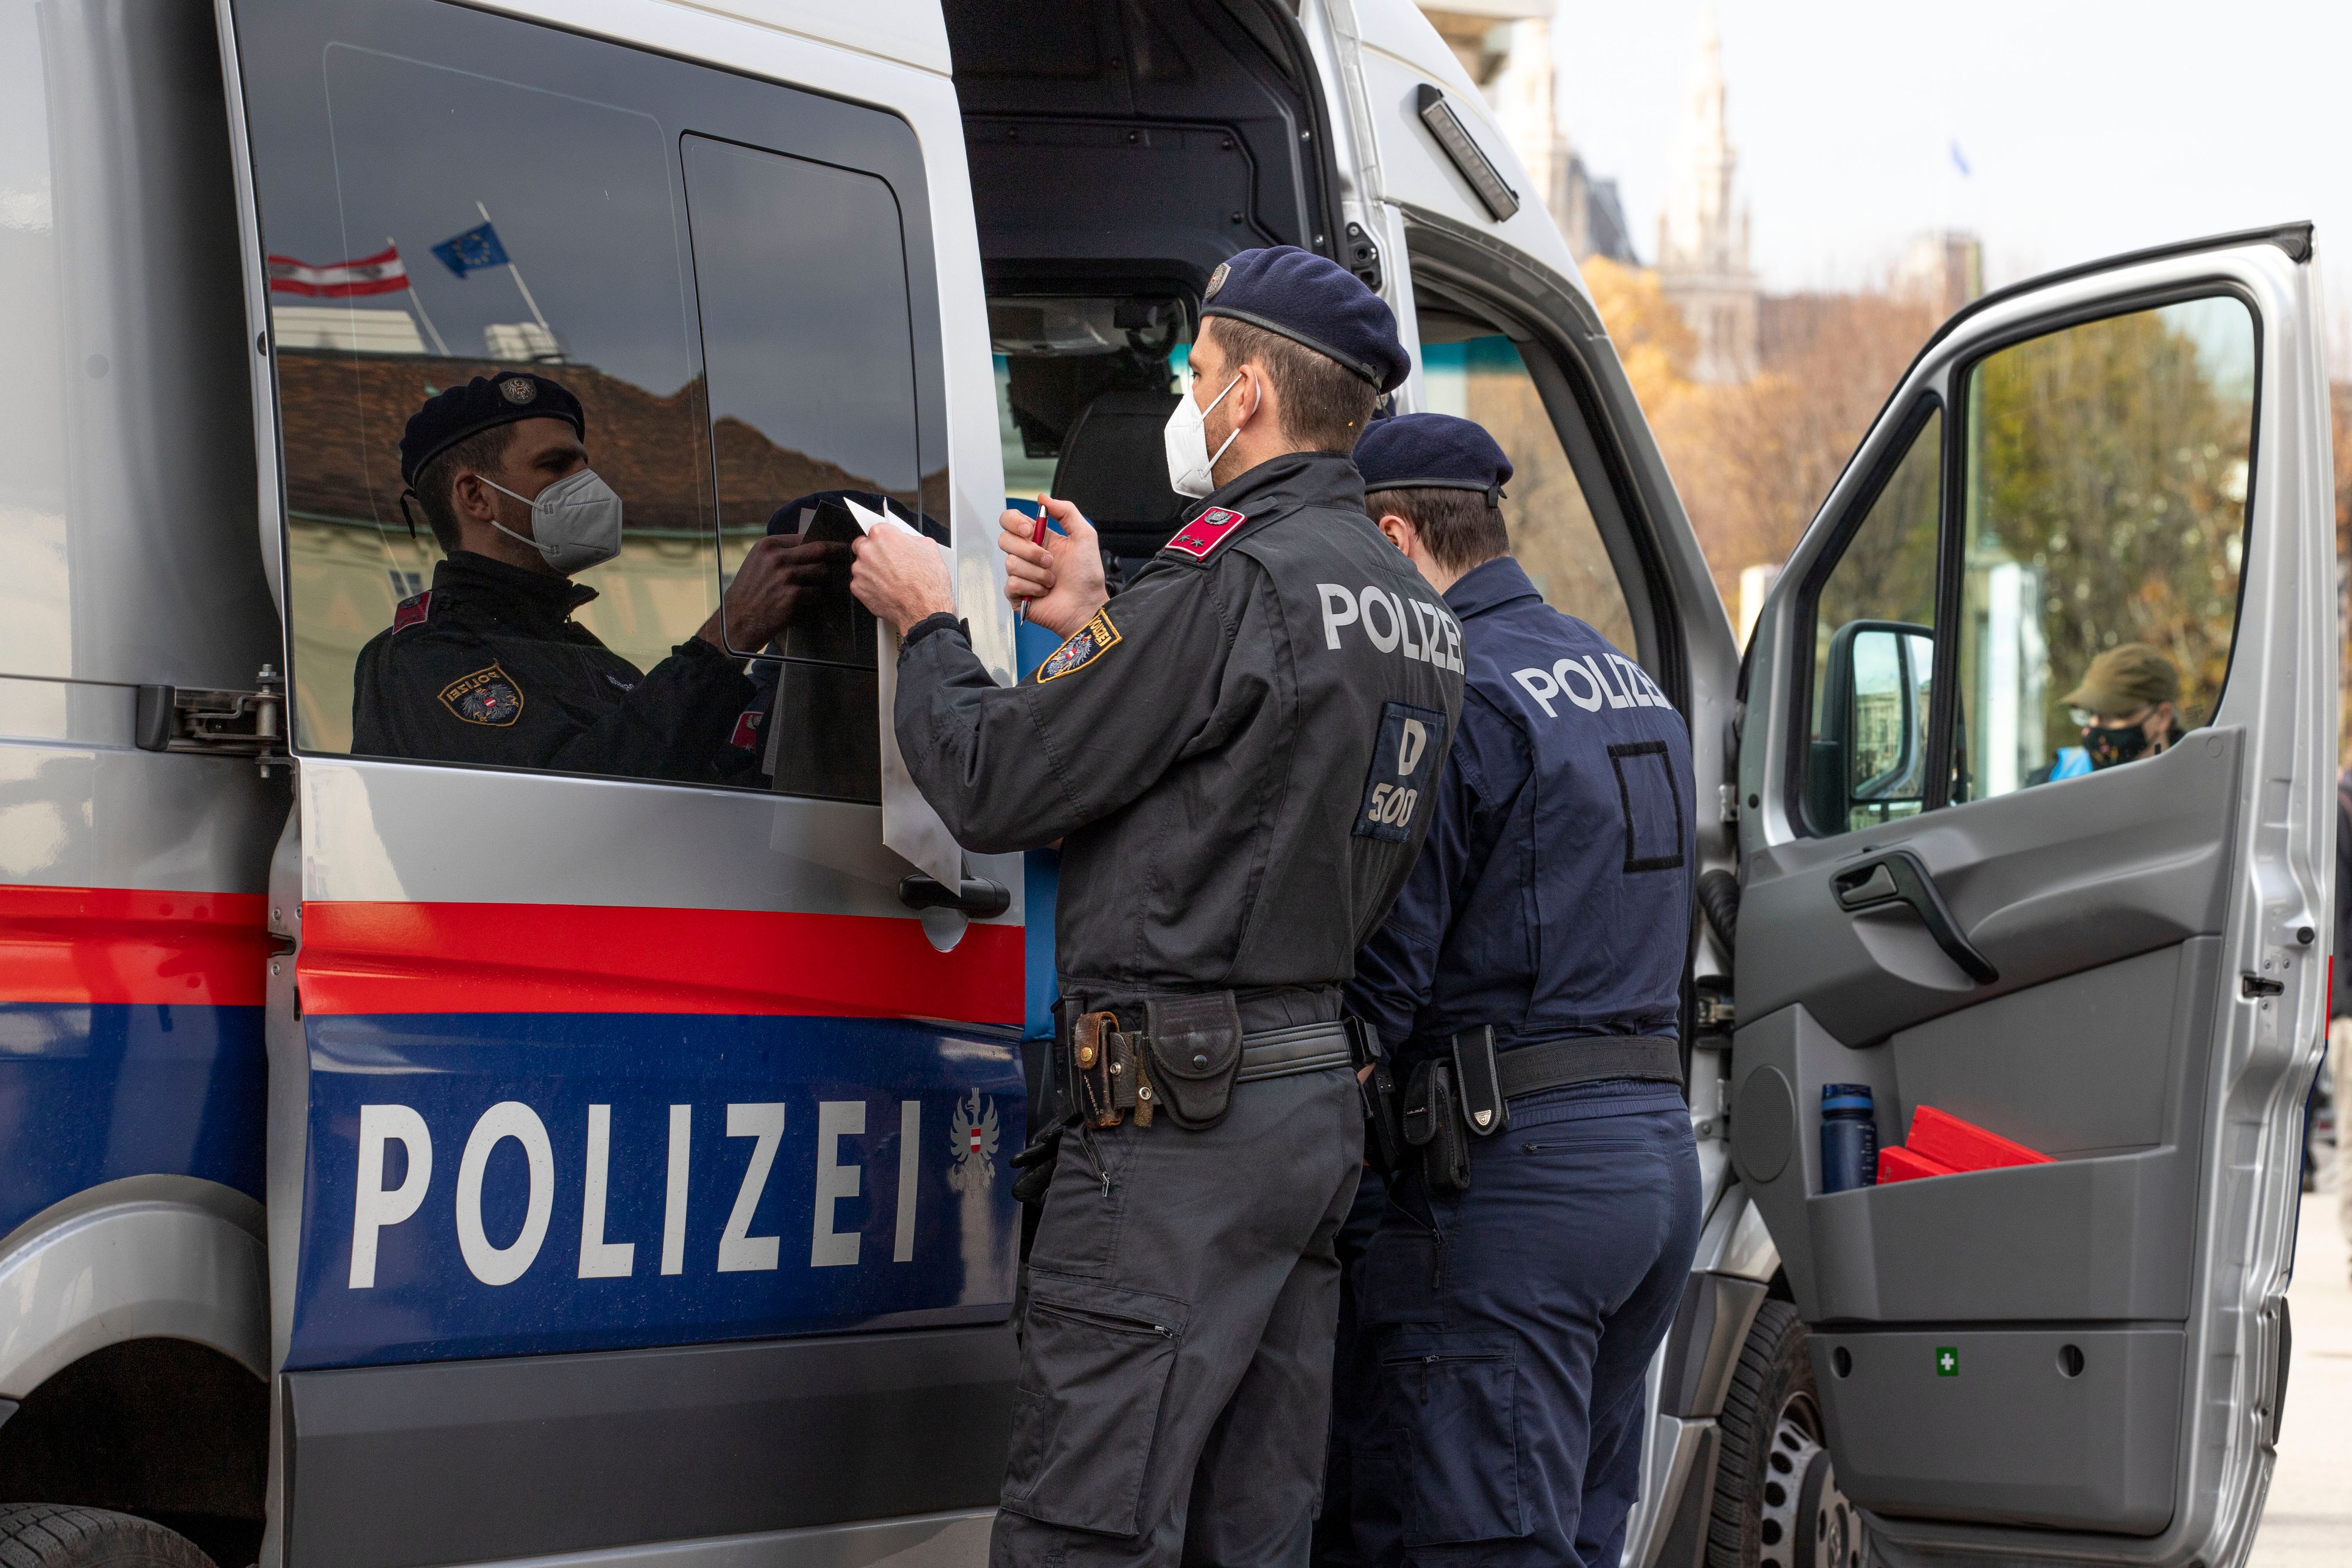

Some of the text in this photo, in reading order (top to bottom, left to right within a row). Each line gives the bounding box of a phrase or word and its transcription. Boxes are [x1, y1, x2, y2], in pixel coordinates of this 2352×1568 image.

[1316, 584, 1464, 676] POLIZEI
[1511, 653, 1673, 718] POLIZEI
[1398, 718, 1427, 775] D
[1368, 783, 1418, 827] 500
[1084, 1074, 1100, 1115] LEATHERMAN
[349, 1100, 921, 1289] POLIZEI
